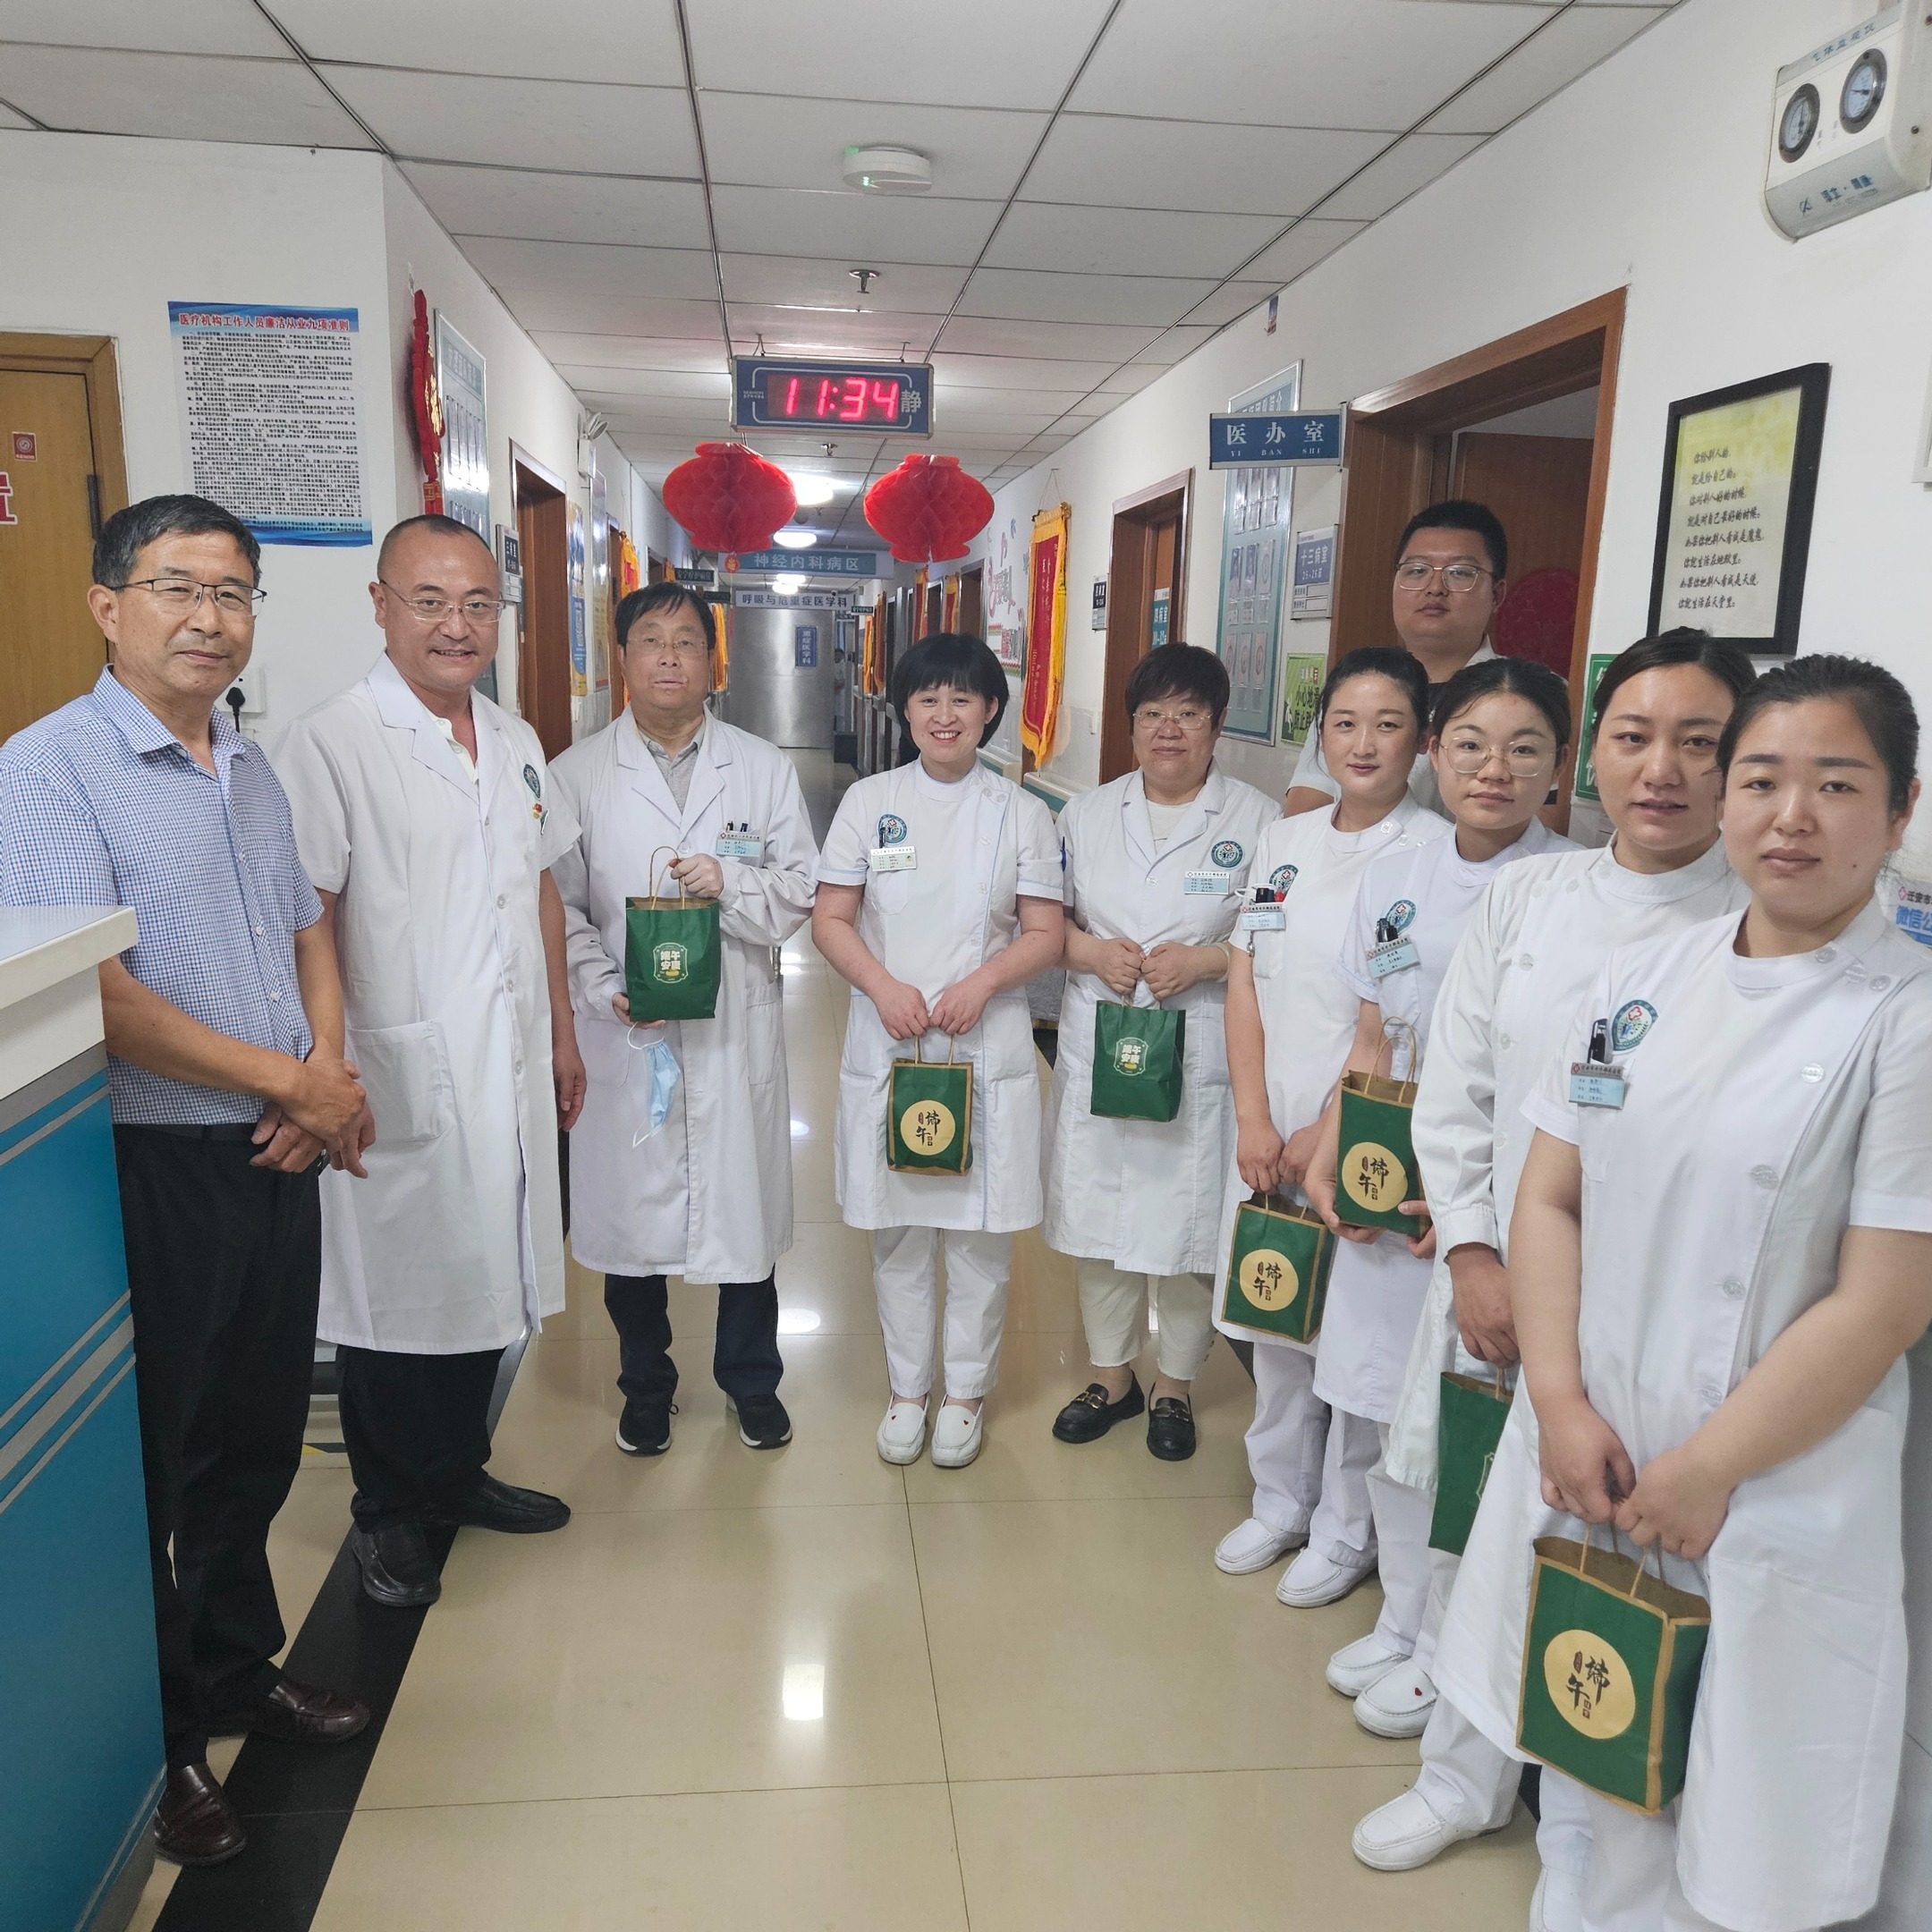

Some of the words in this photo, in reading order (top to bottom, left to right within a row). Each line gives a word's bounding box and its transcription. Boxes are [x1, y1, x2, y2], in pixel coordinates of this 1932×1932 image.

[180, 314, 350, 331] 医疗机构工作人员廉洁从业九项准则
[785, 377, 900, 421] 11:34
[901, 389, 922, 413] 静
[1226, 420, 1325, 445] 医办室
[753, 555, 860, 572] 神经内科病区
[741, 594, 848, 607] 呼吸与危重症医学科
